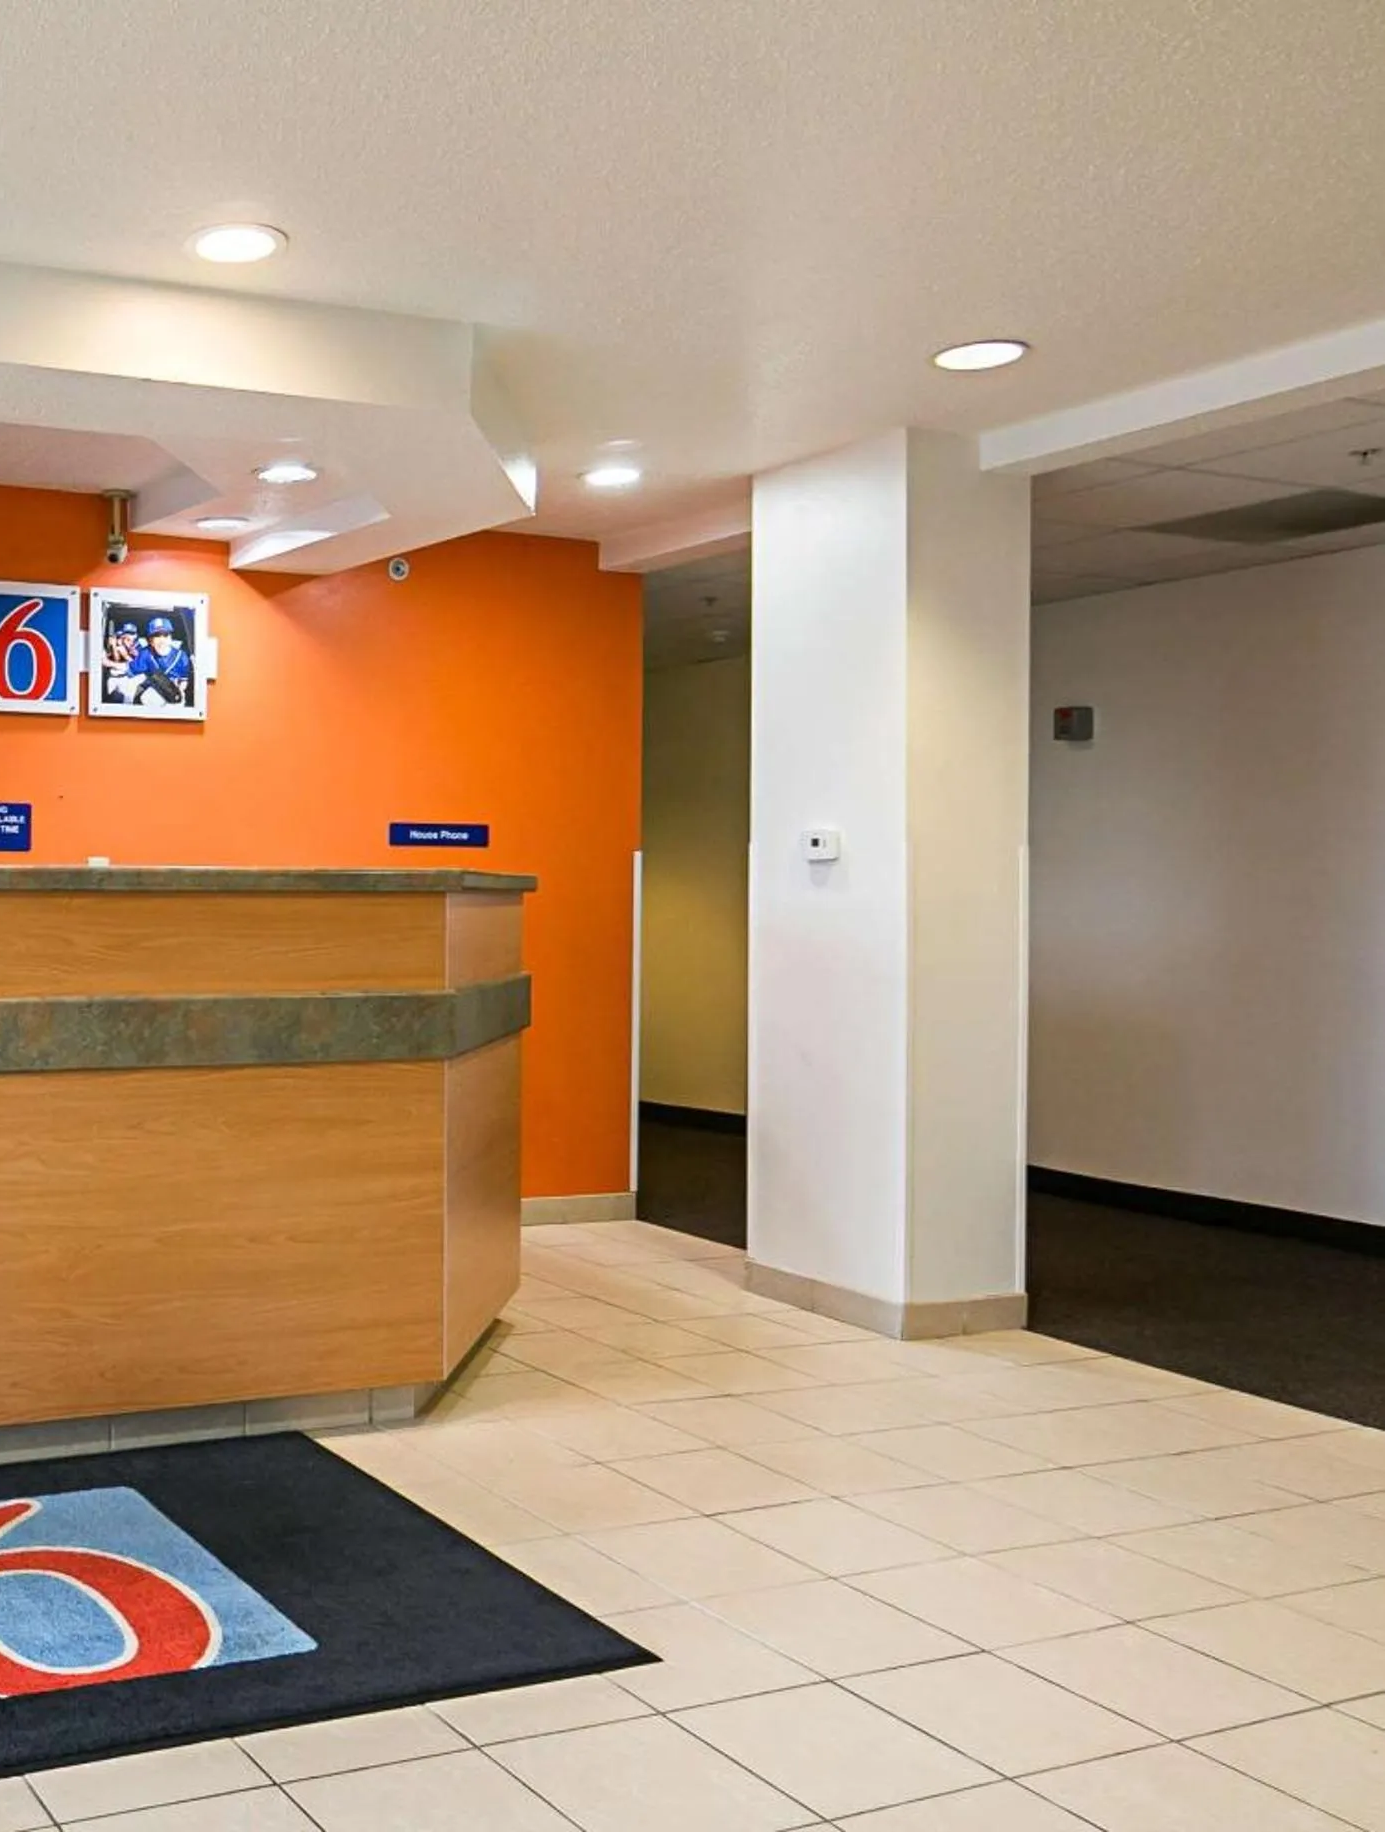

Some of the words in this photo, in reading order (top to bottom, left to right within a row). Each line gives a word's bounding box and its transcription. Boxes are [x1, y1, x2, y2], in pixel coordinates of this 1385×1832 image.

[0, 825, 19, 833] TIME
[409, 829, 438, 839] House
[440, 830, 469, 839] Phone
